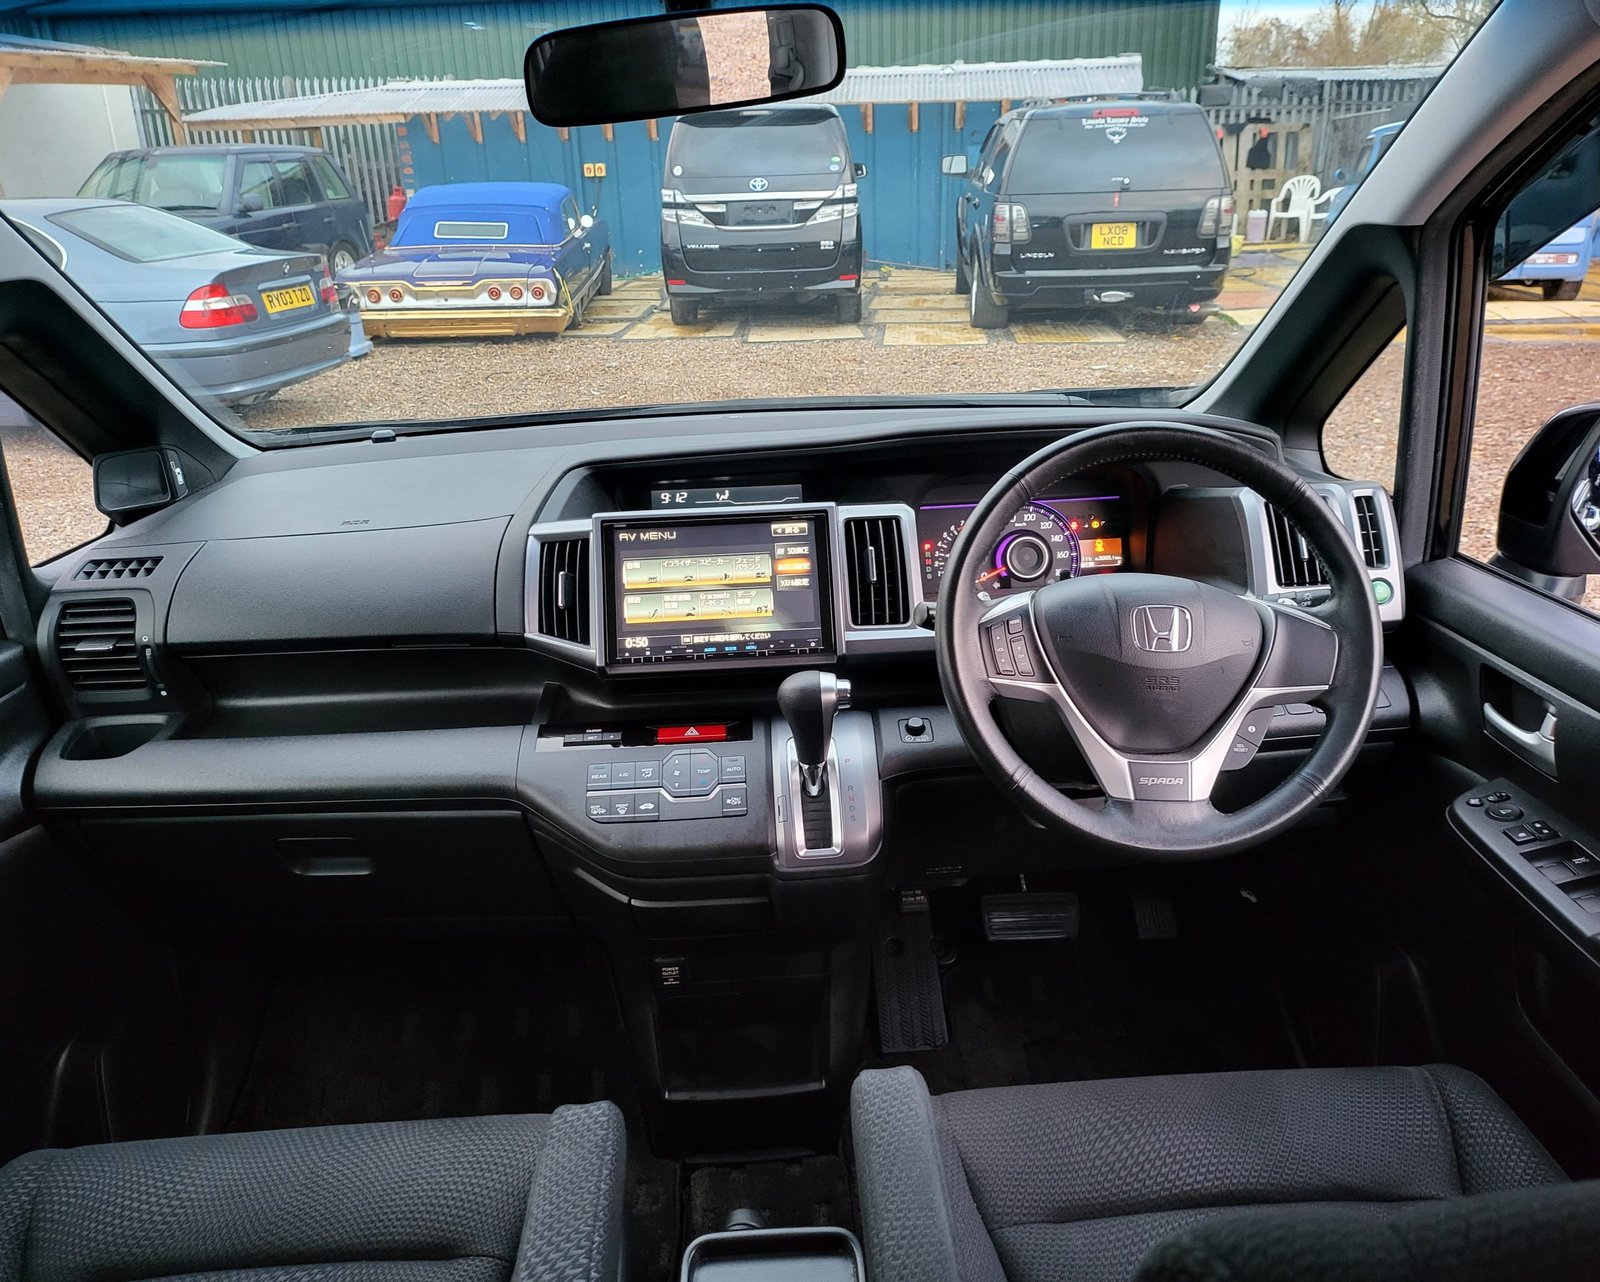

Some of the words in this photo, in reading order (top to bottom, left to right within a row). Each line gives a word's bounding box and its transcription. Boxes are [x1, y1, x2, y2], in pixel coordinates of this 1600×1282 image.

[1100, 225, 1129, 236] LX08
[1103, 236, 1124, 246] NCD
[266, 291, 294, 309] RY03
[660, 492, 688, 504] 9:12
[1023, 513, 1037, 522] 100
[1040, 521, 1053, 530] 120
[619, 533, 637, 542] AV
[640, 531, 677, 541] MENU
[1051, 534, 1063, 543] 140
[787, 546, 810, 554] SOURCE
[1056, 550, 1069, 559] 160
[624, 636, 649, 649] 0:50
[1145, 676, 1180, 685] SRS
[1138, 777, 1184, 786] SPADA
